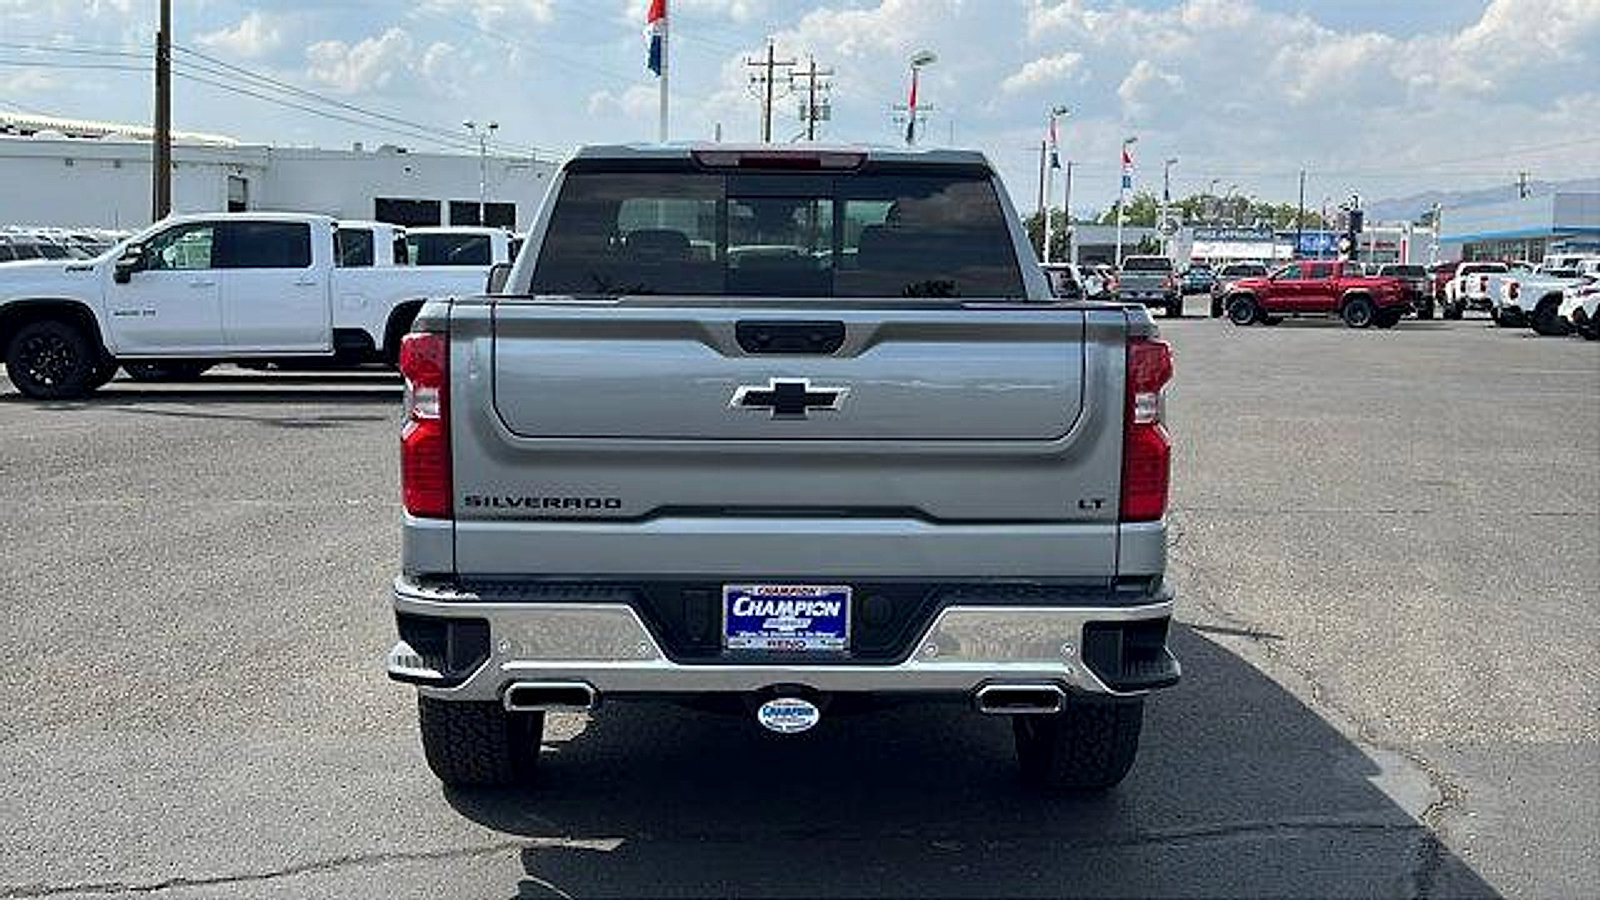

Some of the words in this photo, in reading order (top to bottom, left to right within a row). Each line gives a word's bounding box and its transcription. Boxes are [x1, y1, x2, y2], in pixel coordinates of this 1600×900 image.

[464, 496, 622, 509] SILVERADO
[1078, 498, 1106, 509] LT
[732, 597, 841, 617] CHAMPION
